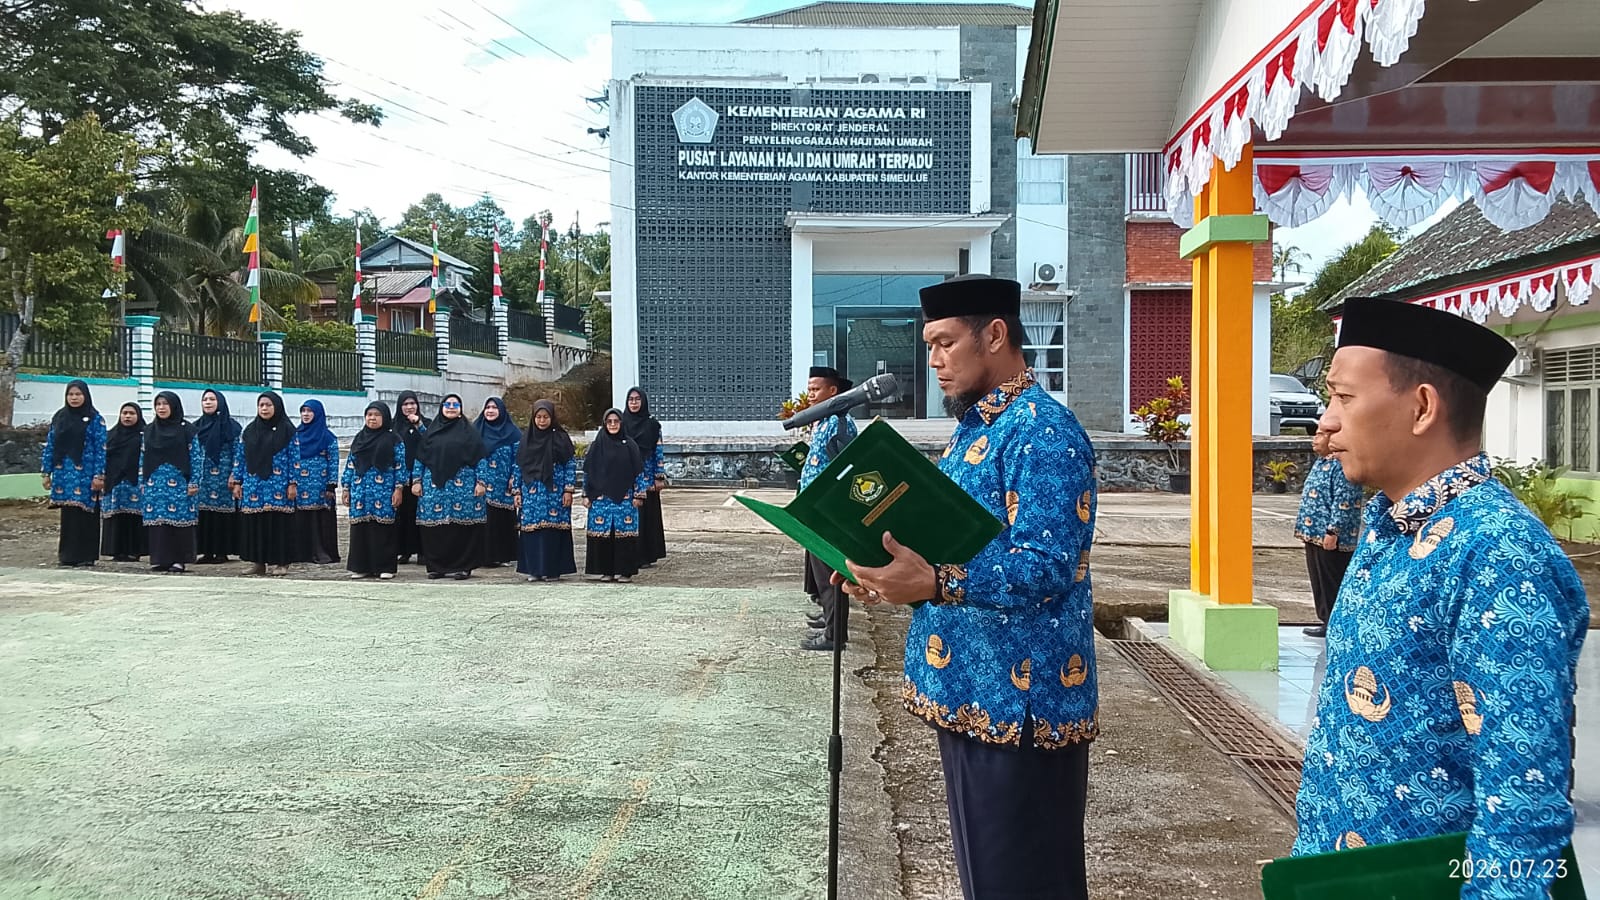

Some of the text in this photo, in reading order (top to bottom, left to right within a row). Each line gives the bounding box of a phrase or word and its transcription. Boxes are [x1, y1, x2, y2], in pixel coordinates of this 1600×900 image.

[727, 105, 925, 119] KEMENTERIAN AGAMA RI
[771, 122, 889, 132] DIREKTORAT JENDERAL
[743, 135, 933, 147] PENYELENGGARAAN HAJI DAN UMRAH
[678, 150, 933, 169] PUSAT LAYANAN HAJI DAN UMRAH TERPADU
[679, 171, 928, 182] KANTOR KEMENTERIAN AGAMA KABUPATEN SIMEULUE
